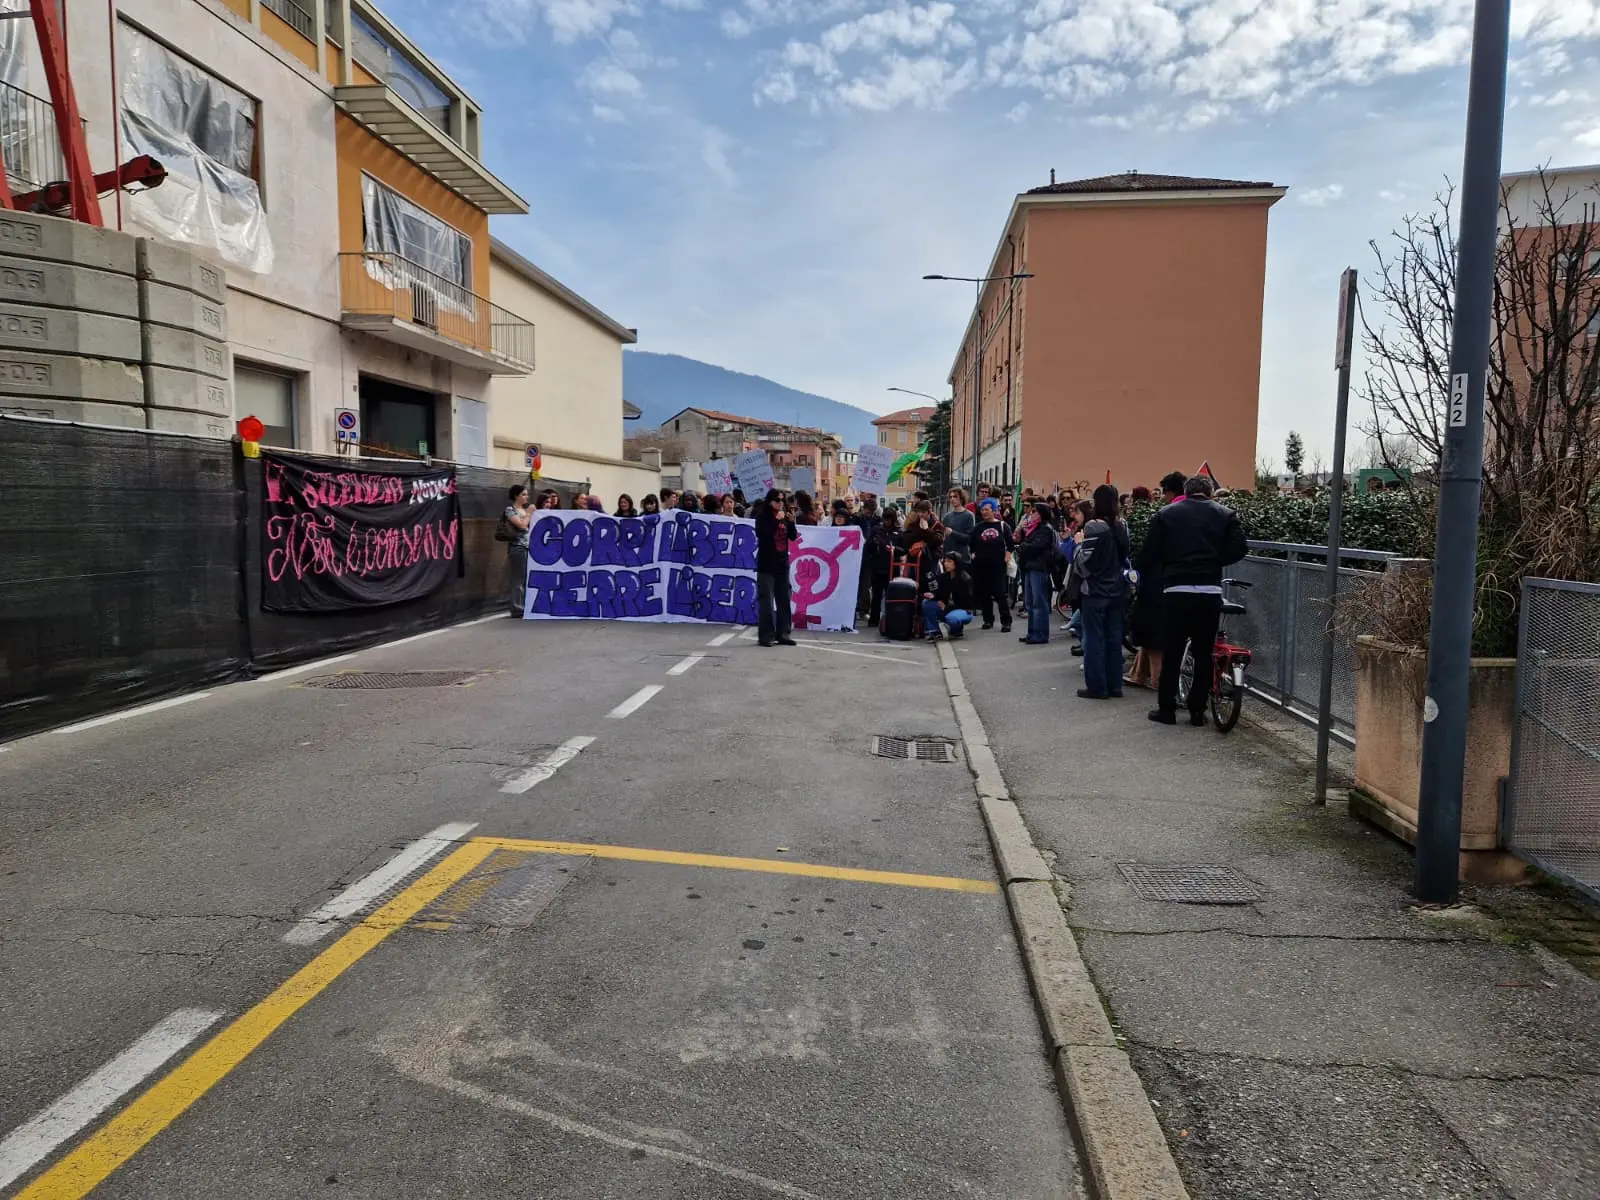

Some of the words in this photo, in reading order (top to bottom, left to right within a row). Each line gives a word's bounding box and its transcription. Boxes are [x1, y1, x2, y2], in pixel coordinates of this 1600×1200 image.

[1453, 376, 1463, 422] 122
[658, 512, 759, 569] LiBER
[528, 569, 663, 618] TERRE
[666, 566, 759, 625] LiBER
